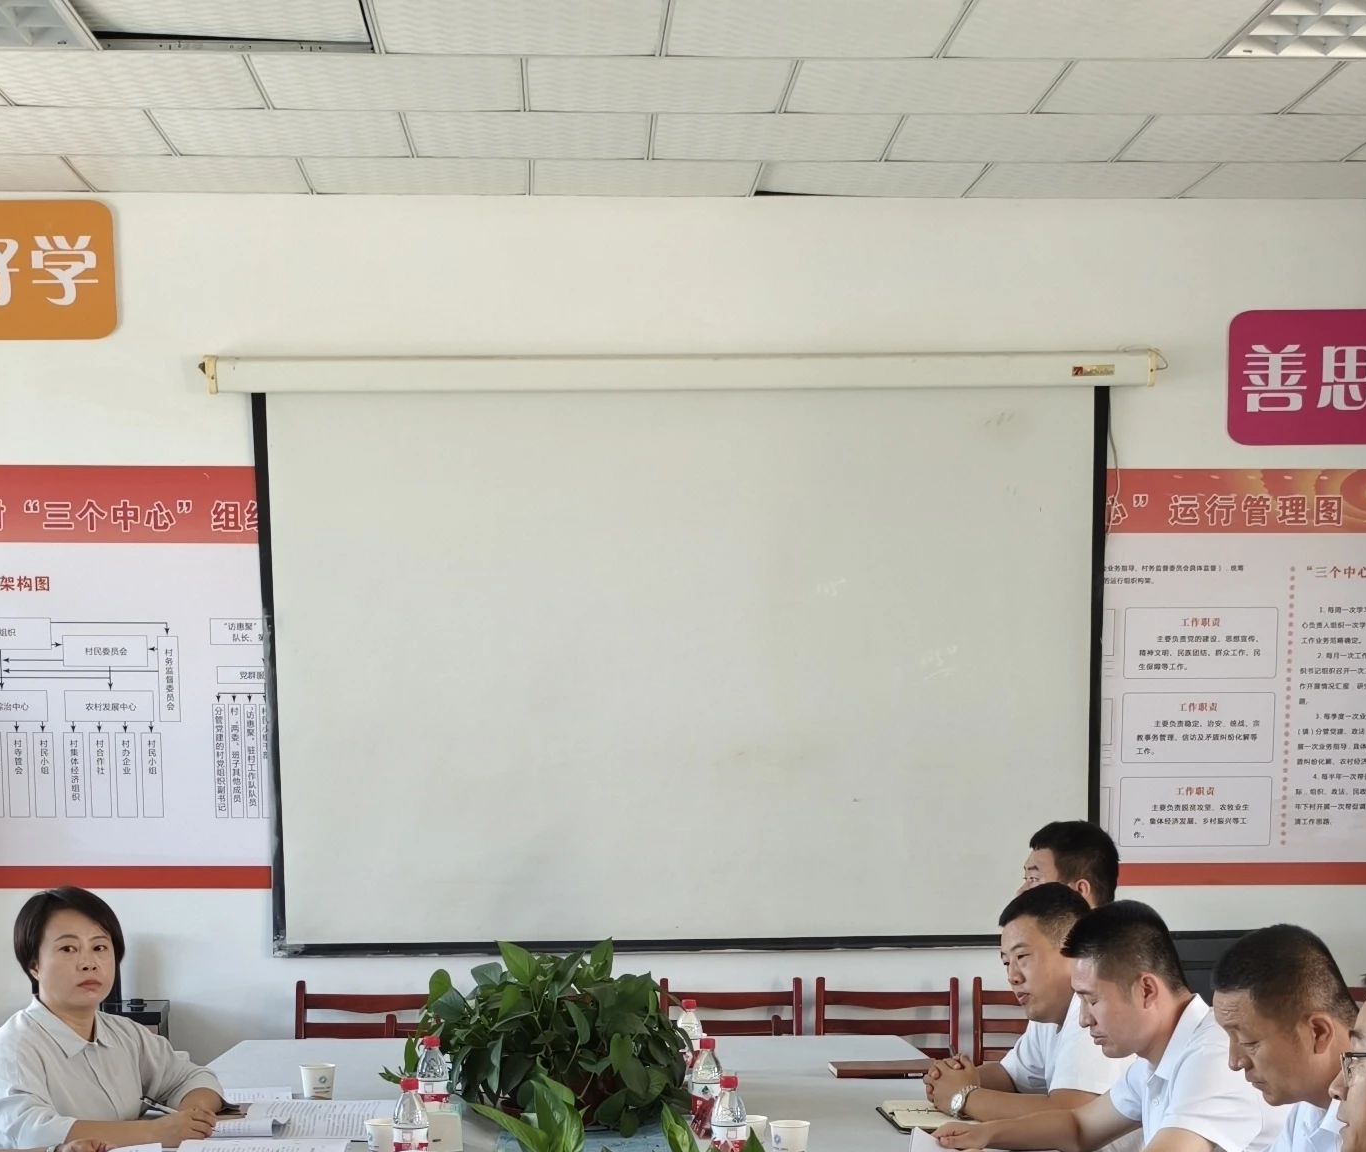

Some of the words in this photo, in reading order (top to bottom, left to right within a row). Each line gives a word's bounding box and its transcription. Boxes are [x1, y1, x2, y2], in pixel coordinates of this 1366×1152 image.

[1180, 617, 1221, 627] 工作职责
[85, 647, 128, 656] 村民委员会
[164, 648, 175, 711] 村务监督委员会
[85, 702, 137, 712] 农村发展中心
[1179, 702, 1218, 712] 工作职责
[39, 739, 50, 775] 村民小组
[69, 739, 81, 801] 村集体经济组织
[95, 739, 105, 775] 村合作社
[121, 739, 132, 775] 村办企业
[147, 739, 158, 775] 村民小组
[1176, 786, 1215, 796] 工作职责
